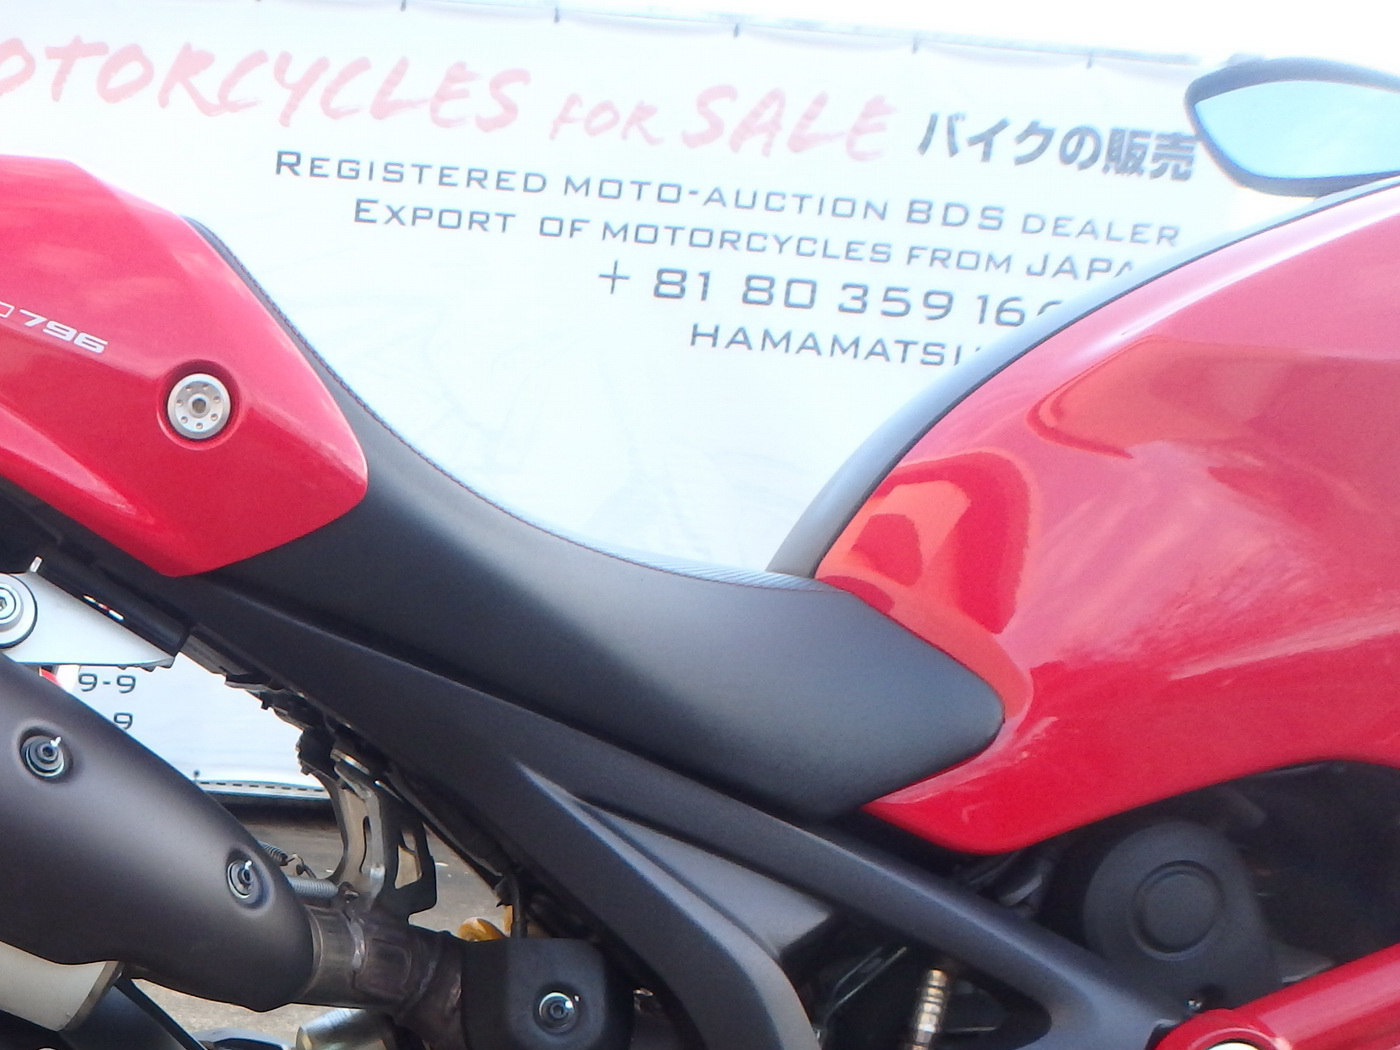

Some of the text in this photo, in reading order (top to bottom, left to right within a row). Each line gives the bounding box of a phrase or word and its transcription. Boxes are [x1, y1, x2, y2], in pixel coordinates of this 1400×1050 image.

[549, 92, 664, 146] FOR
[681, 84, 898, 162] SALE
[917, 112, 1196, 182] バイクの販売
[275, 150, 1180, 246] REGISTERED MOTO-AUCTION BDS DEALER
[354, 198, 517, 234] EXPORT
[539, 215, 591, 239] OF
[602, 221, 892, 265] MOTORCYCLES
[906, 246, 1013, 275] FROM
[653, 267, 712, 302] 81
[741, 273, 818, 310] 80
[837, 281, 955, 321] 359
[18, 308, 110, 354] 796
[78, 672, 137, 694] 9-9
[113, 712, 134, 731] 9
